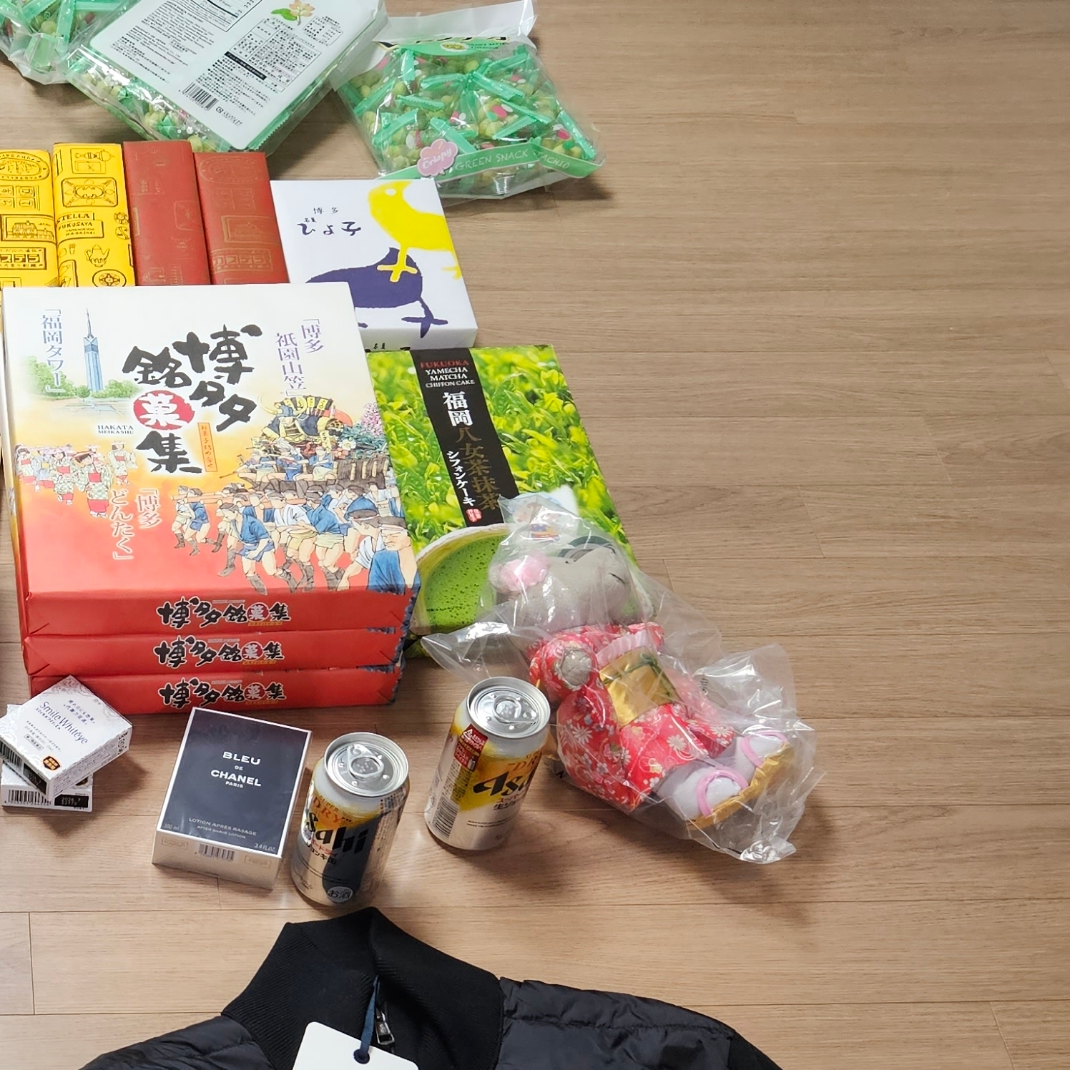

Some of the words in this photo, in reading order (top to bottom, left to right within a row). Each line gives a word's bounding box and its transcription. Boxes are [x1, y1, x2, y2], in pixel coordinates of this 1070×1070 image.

[421, 149, 453, 170] Crispy
[455, 155, 492, 170] GREEN
[495, 149, 529, 162] SNACK
[313, 206, 339, 215] 博多
[420, 360, 470, 368] FUKUOKA
[425, 366, 468, 375] YAMECHA
[172, 323, 264, 432] 博多
[425, 380, 456, 388] CHIFFON
[430, 373, 468, 381] MATCHA
[122, 345, 202, 474] 銘菓集
[442, 391, 473, 427] 福岡
[446, 450, 476, 507] シフォンケーキ
[157, 596, 292, 630] 博多銘菓集
[153, 635, 285, 669] 博多銘菓集
[159, 676, 287, 710] 博多銘菓集
[39, 701, 62, 722] Smile
[59, 716, 88, 745] Whiteye
[222, 751, 261, 766] BLEU
[210, 769, 262, 787] CHANEL
[225, 781, 244, 789] PARIS
[188, 817, 211, 826] LOTION
[232, 826, 257, 836] RASAGE
[196, 825, 213, 833] AFTER
[329, 889, 350, 899] お酒
